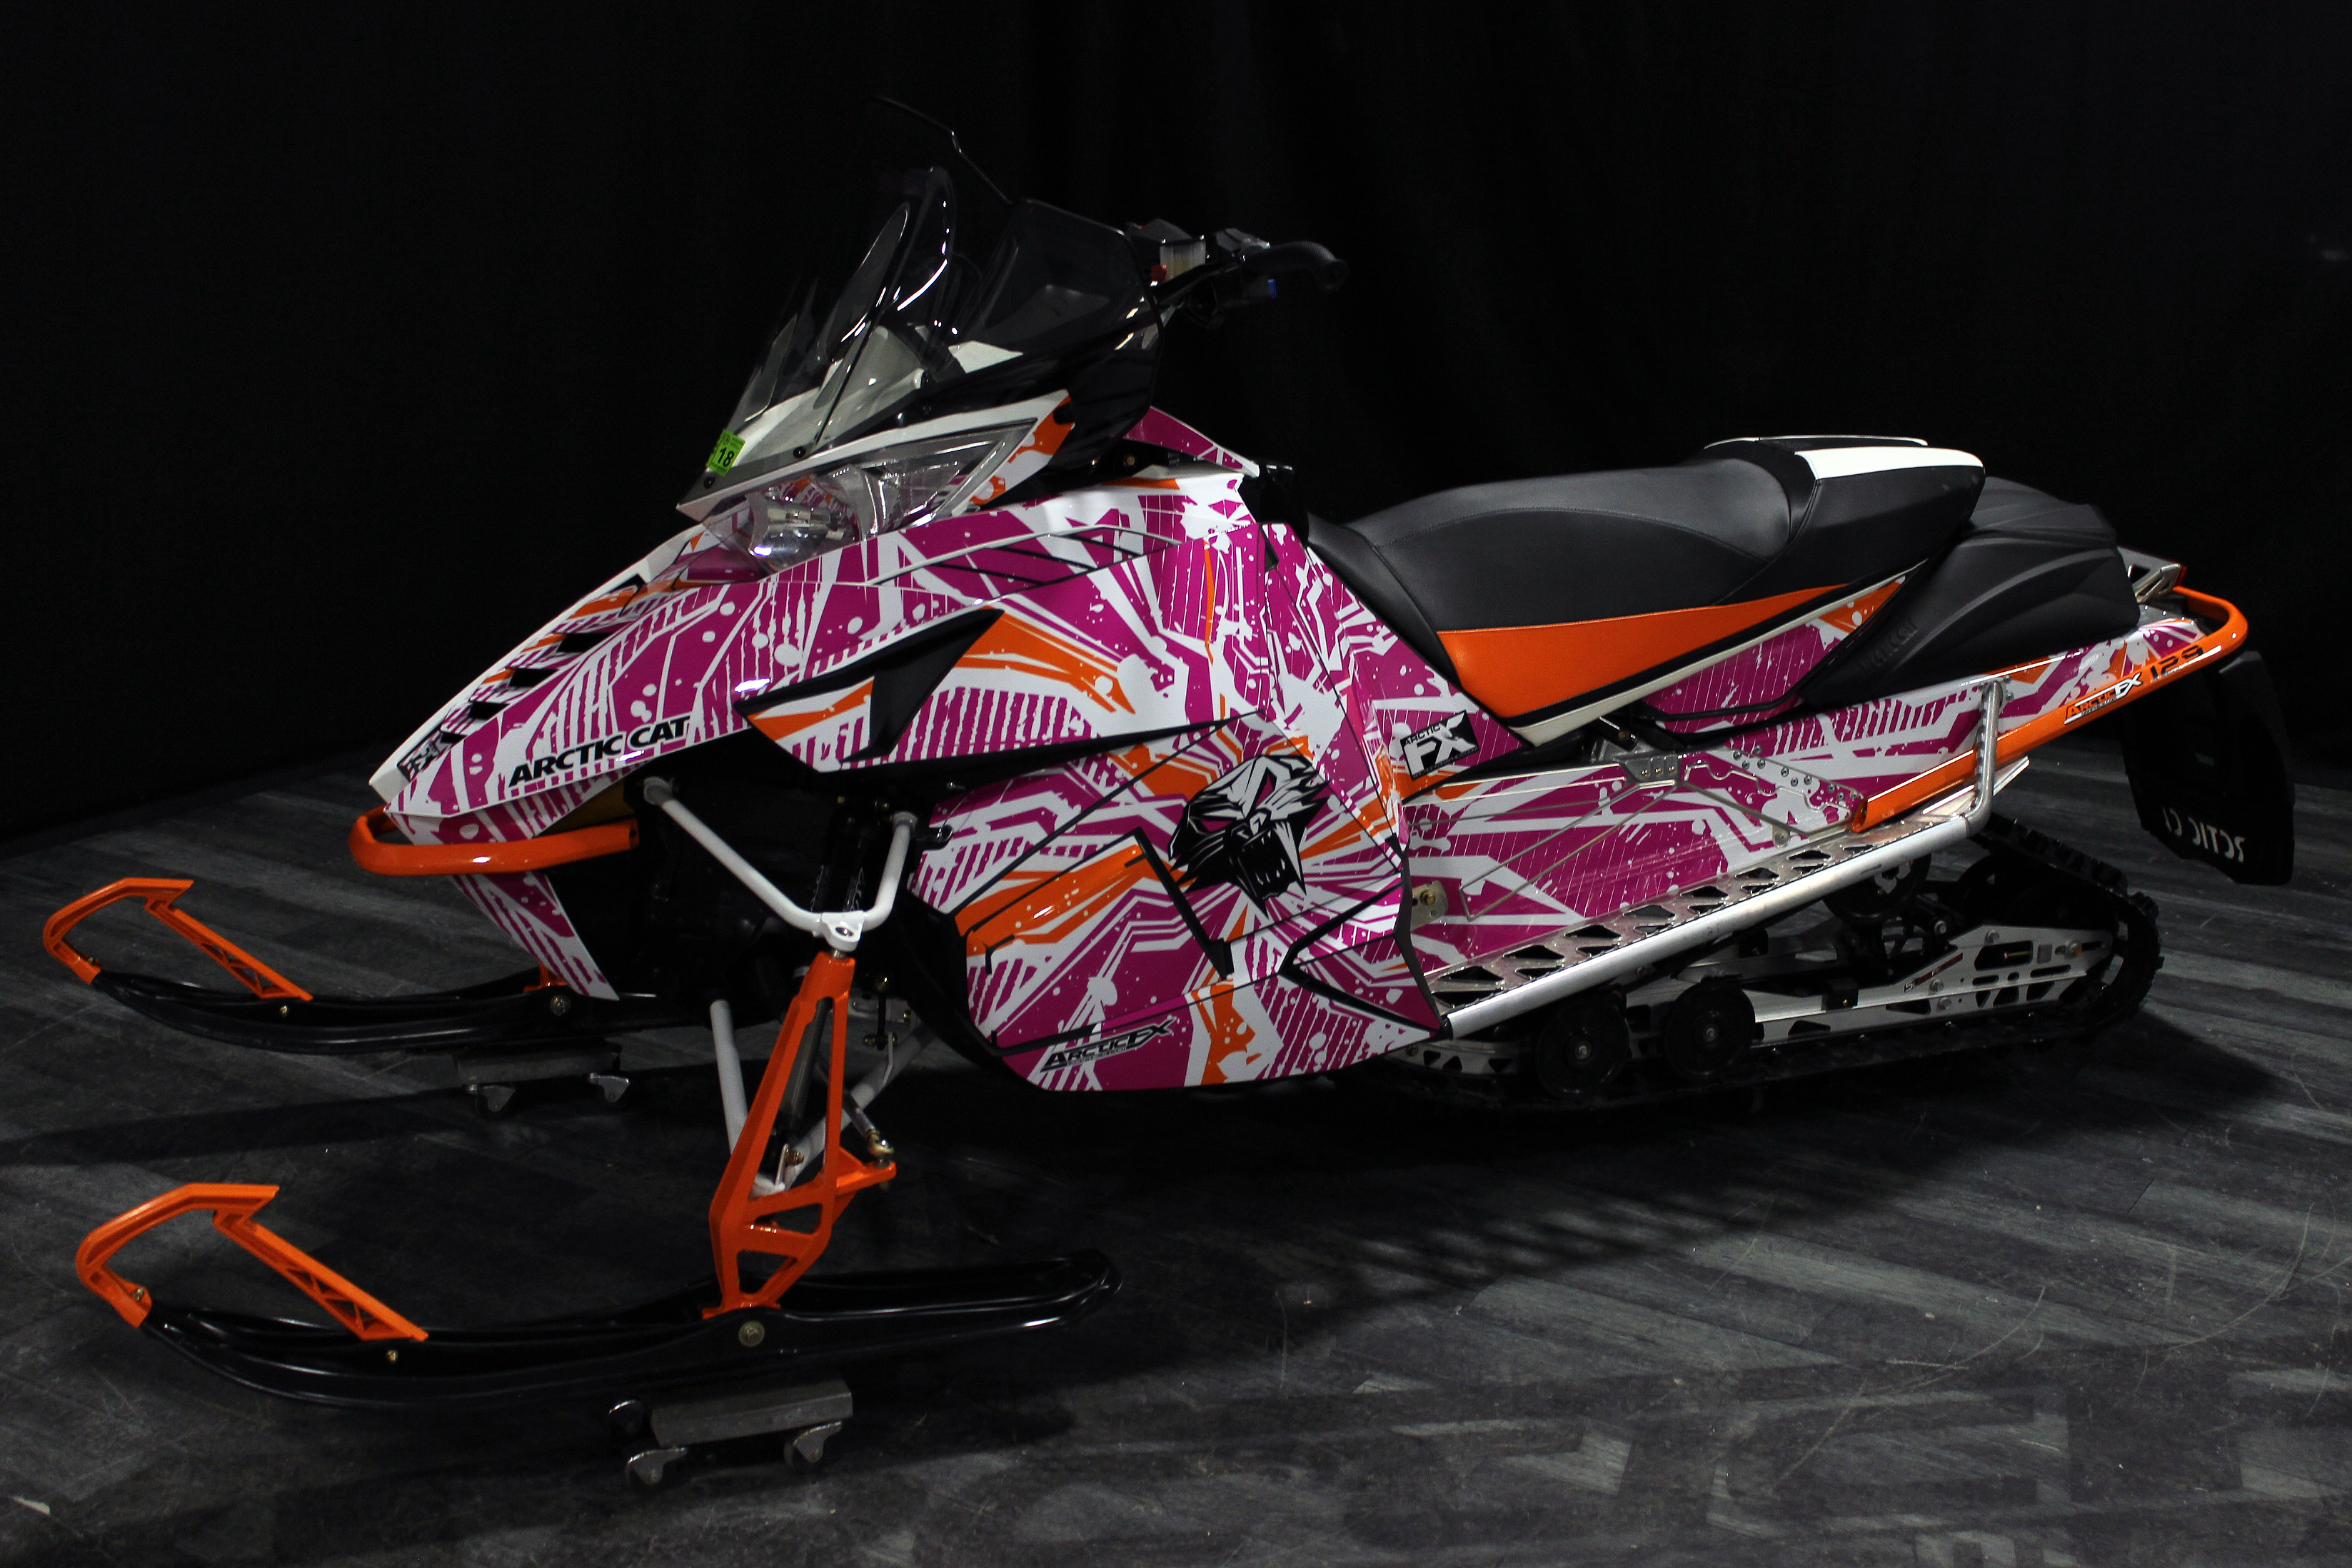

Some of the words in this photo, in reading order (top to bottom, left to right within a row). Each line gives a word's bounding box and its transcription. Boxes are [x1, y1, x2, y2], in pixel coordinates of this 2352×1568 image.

[718, 447, 735, 467] 18
[509, 734, 624, 788] ARCTIC
[629, 715, 690, 748] CAT
[1403, 712, 1476, 775] FX
[1404, 725, 1441, 745] ARCTIC
